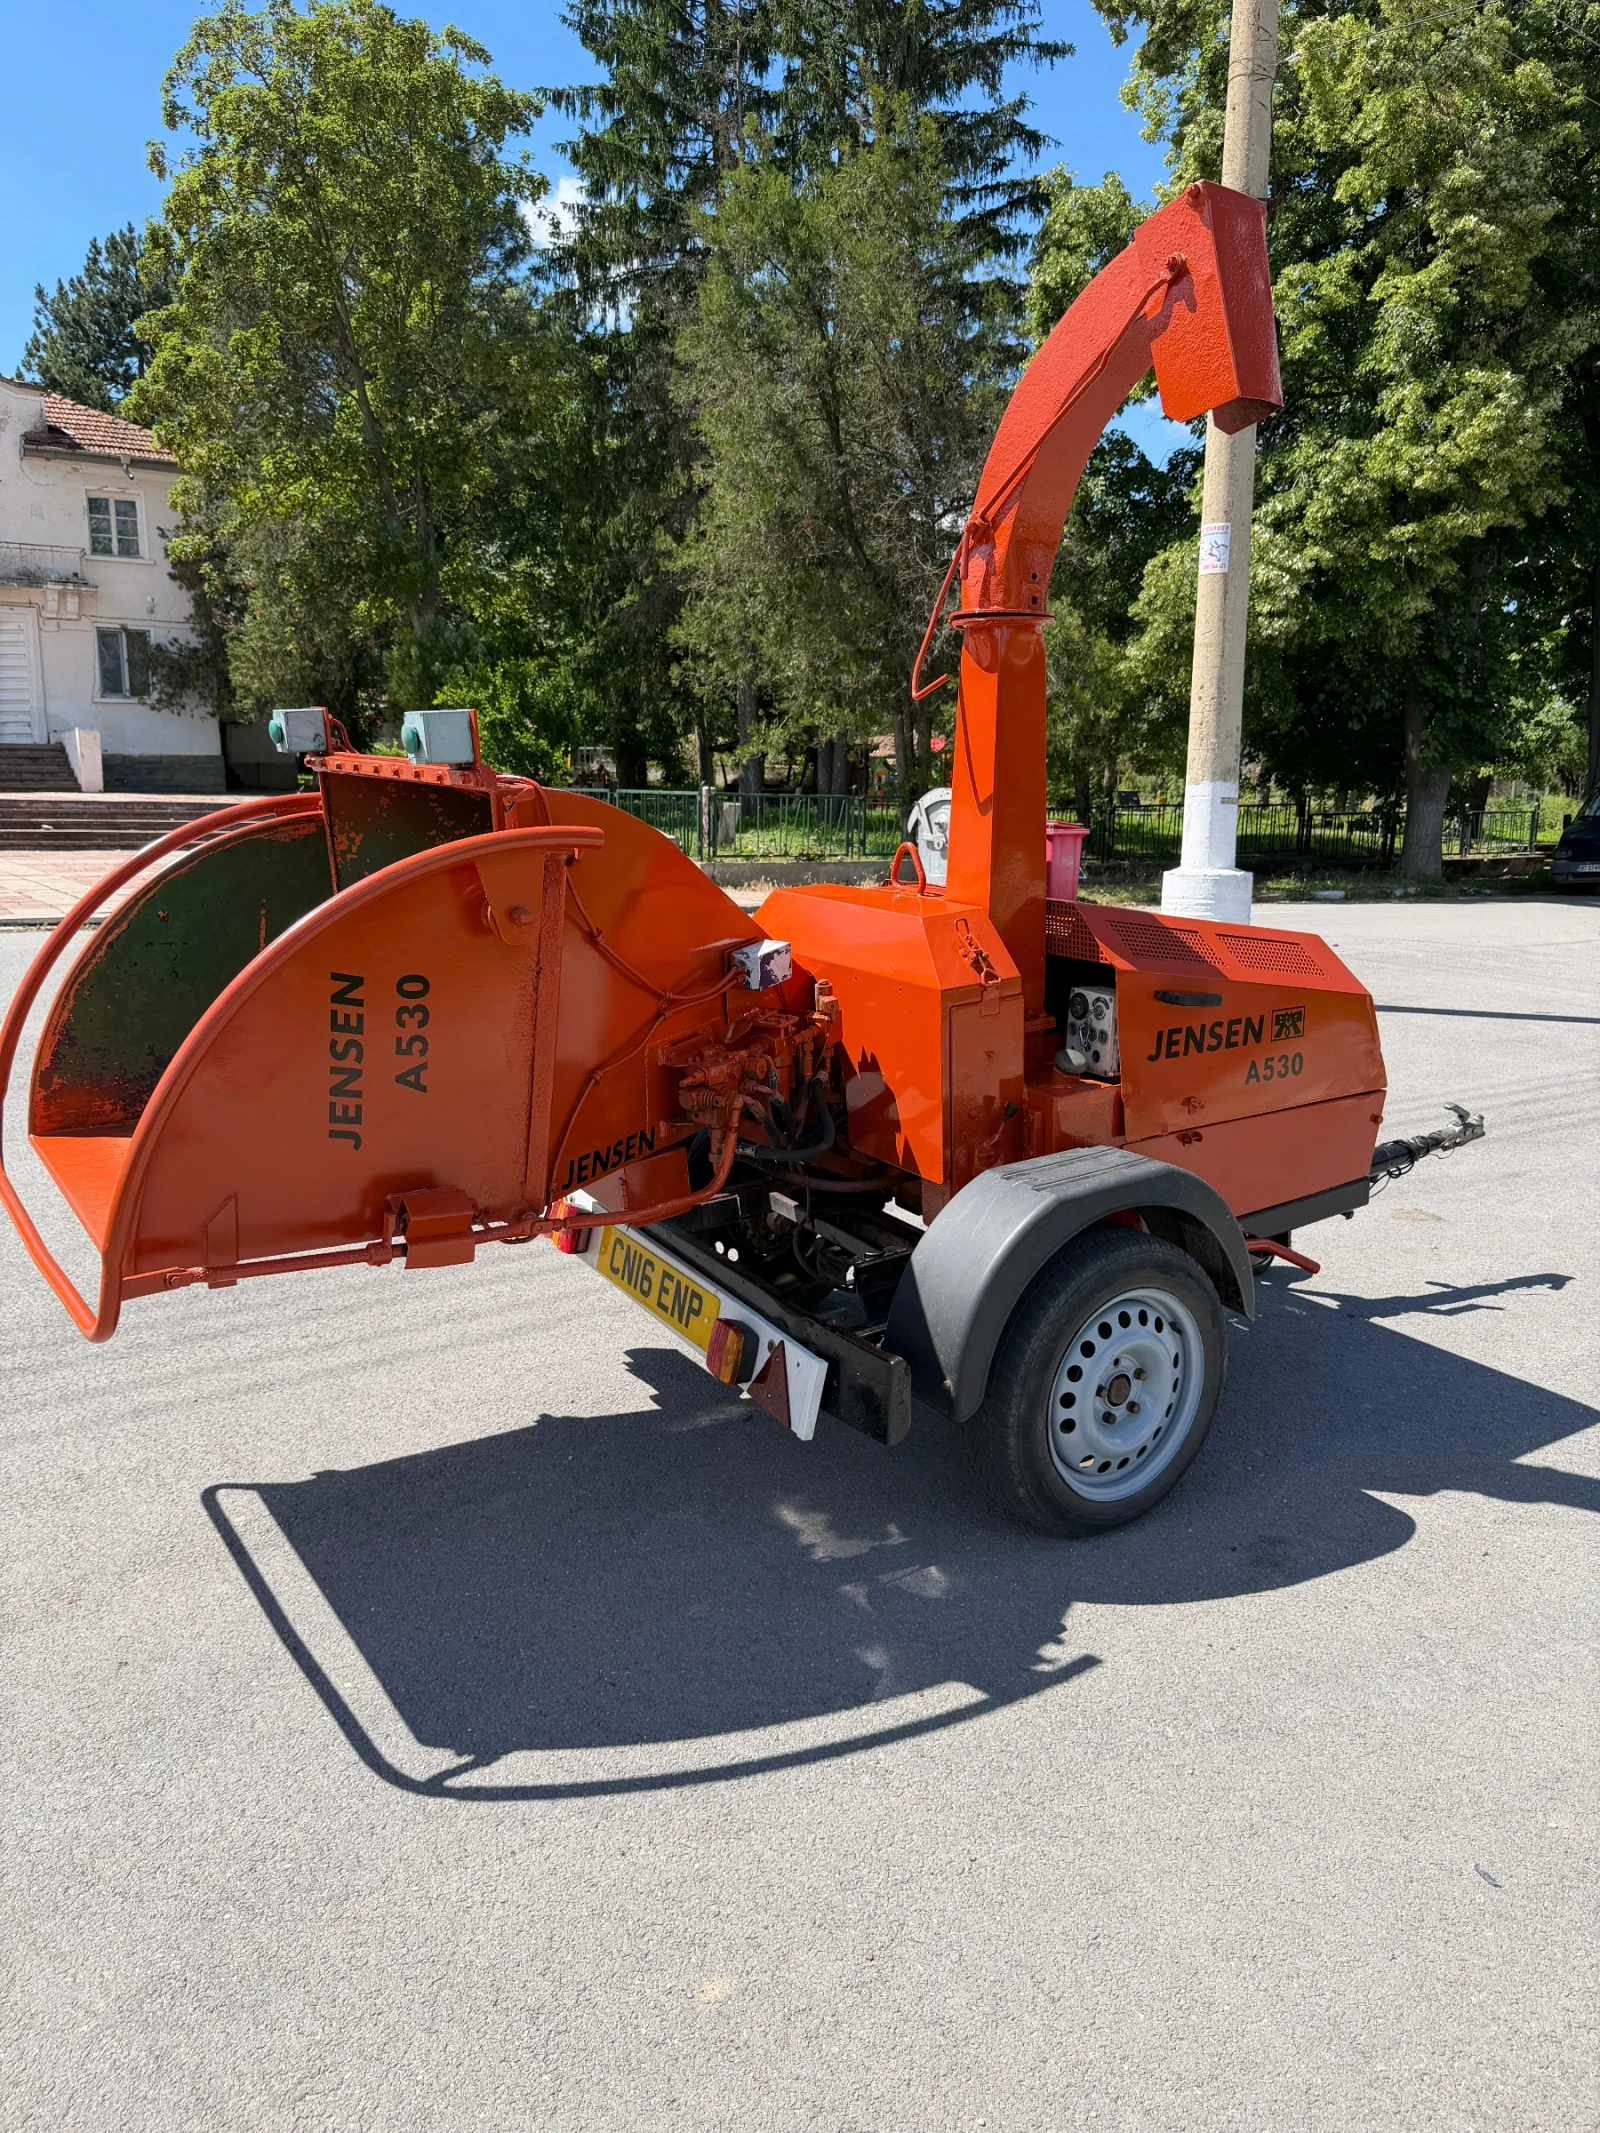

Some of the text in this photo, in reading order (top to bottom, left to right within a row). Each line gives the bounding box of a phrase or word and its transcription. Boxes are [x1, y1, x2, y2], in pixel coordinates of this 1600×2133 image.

[328, 972, 364, 1151] JENSEN
[395, 974, 430, 1093] A530
[1147, 1014, 1265, 1062] JENSEN
[1244, 1051, 1304, 1085] A530
[561, 1126, 656, 1190] JENSEN
[609, 1237, 704, 1329] CN16 ENP
